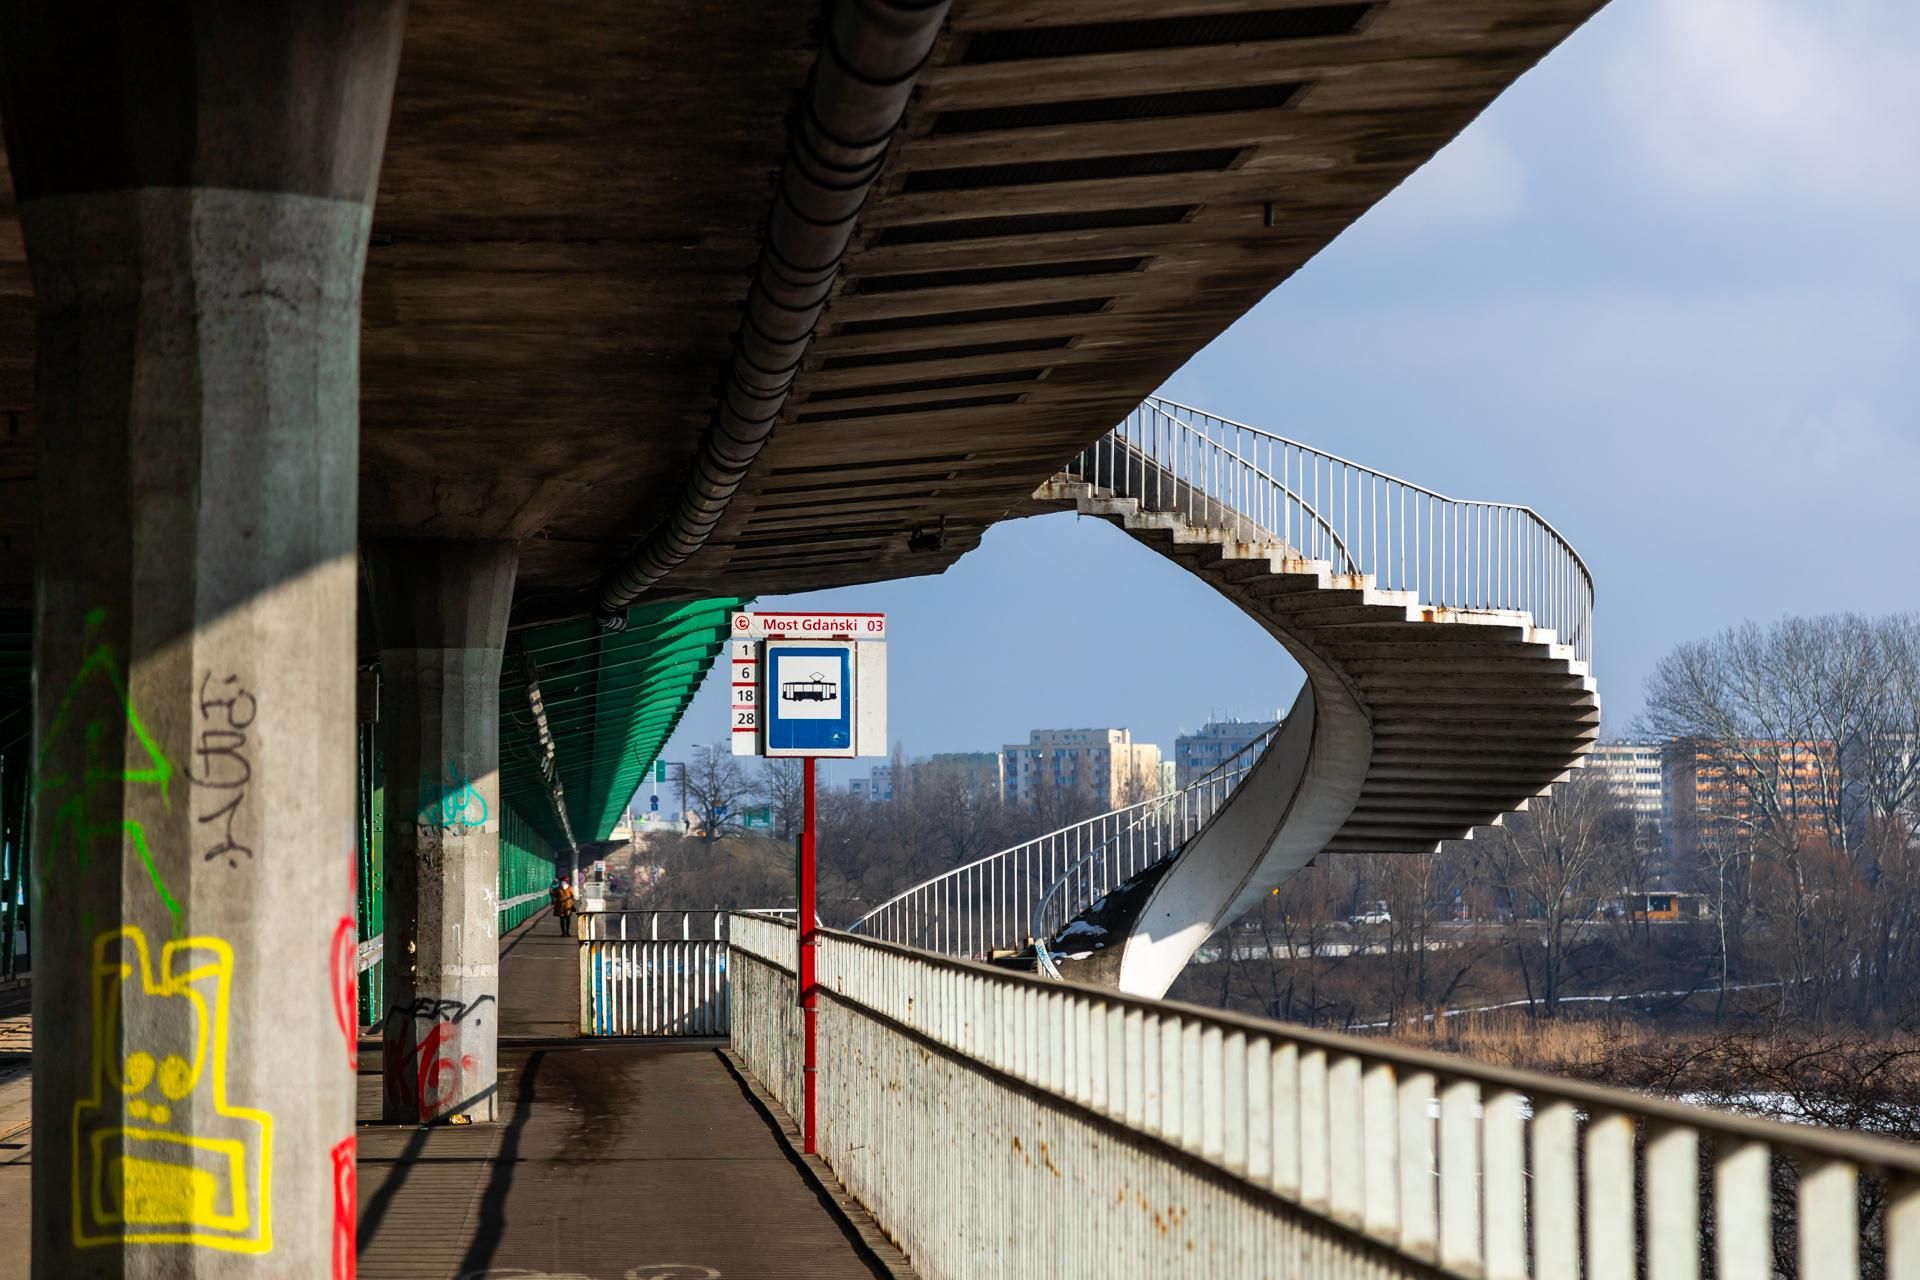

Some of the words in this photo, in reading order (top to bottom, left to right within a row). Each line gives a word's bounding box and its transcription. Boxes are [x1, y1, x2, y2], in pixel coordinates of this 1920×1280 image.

[763, 619, 798, 631] Most
[802, 618, 857, 631] Gdański
[867, 620, 883, 632] 03
[742, 644, 748, 656] 1
[741, 667, 750, 679] 6
[737, 690, 754, 702] 18
[737, 712, 755, 725] 28
